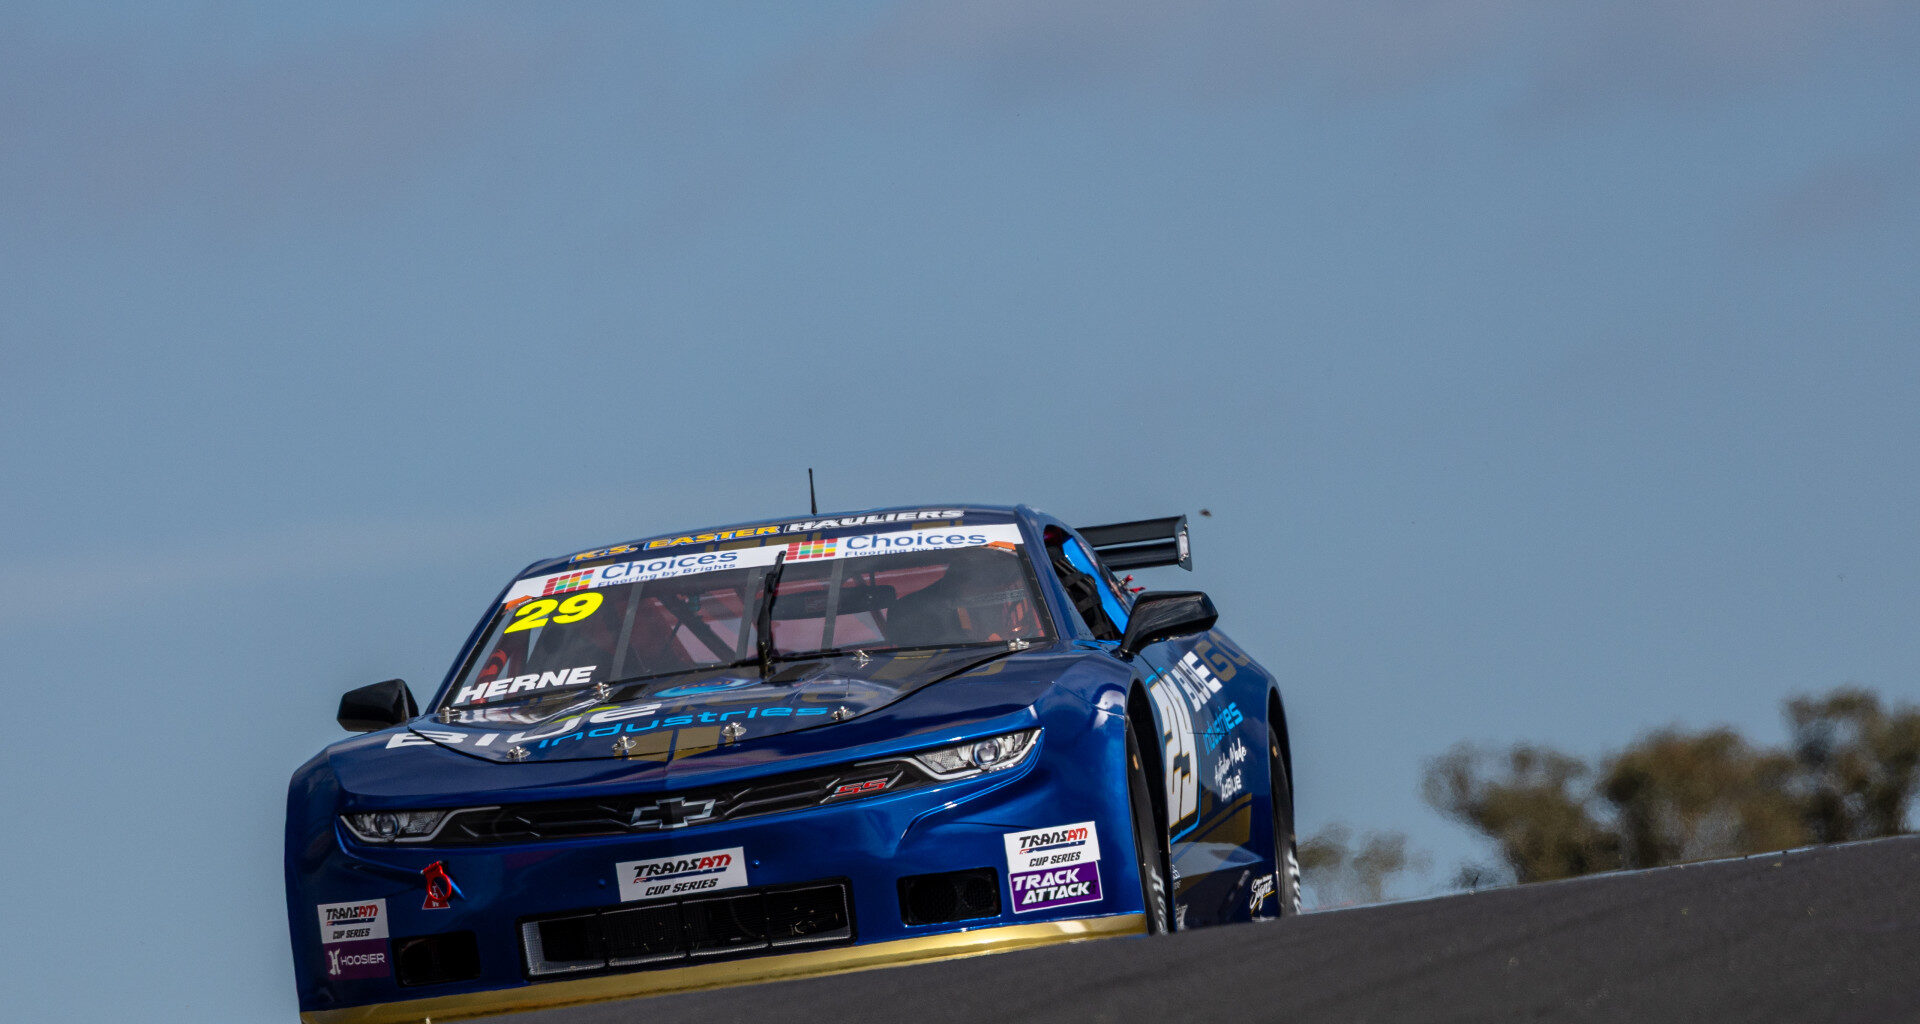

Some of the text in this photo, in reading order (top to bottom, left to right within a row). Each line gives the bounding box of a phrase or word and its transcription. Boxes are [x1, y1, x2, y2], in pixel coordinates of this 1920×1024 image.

[643, 525, 780, 550] EASTER
[784, 511, 964, 533] HAULIERS
[846, 532, 987, 549] Choices
[598, 562, 736, 587] Flooring by Brights
[601, 551, 738, 579] Choices
[503, 592, 604, 634] 29
[454, 665, 597, 704] HERNE
[538, 706, 828, 748] industries
[831, 778, 888, 797] SS
[1029, 851, 1081, 867] CUP SERIES
[645, 878, 718, 896] CUP SERIES
[1013, 868, 1080, 891] TRACK
[1021, 881, 1091, 905] ATTACK
[333, 928, 370, 940] CUP SERIES
[340, 952, 385, 965] HOOSIER
